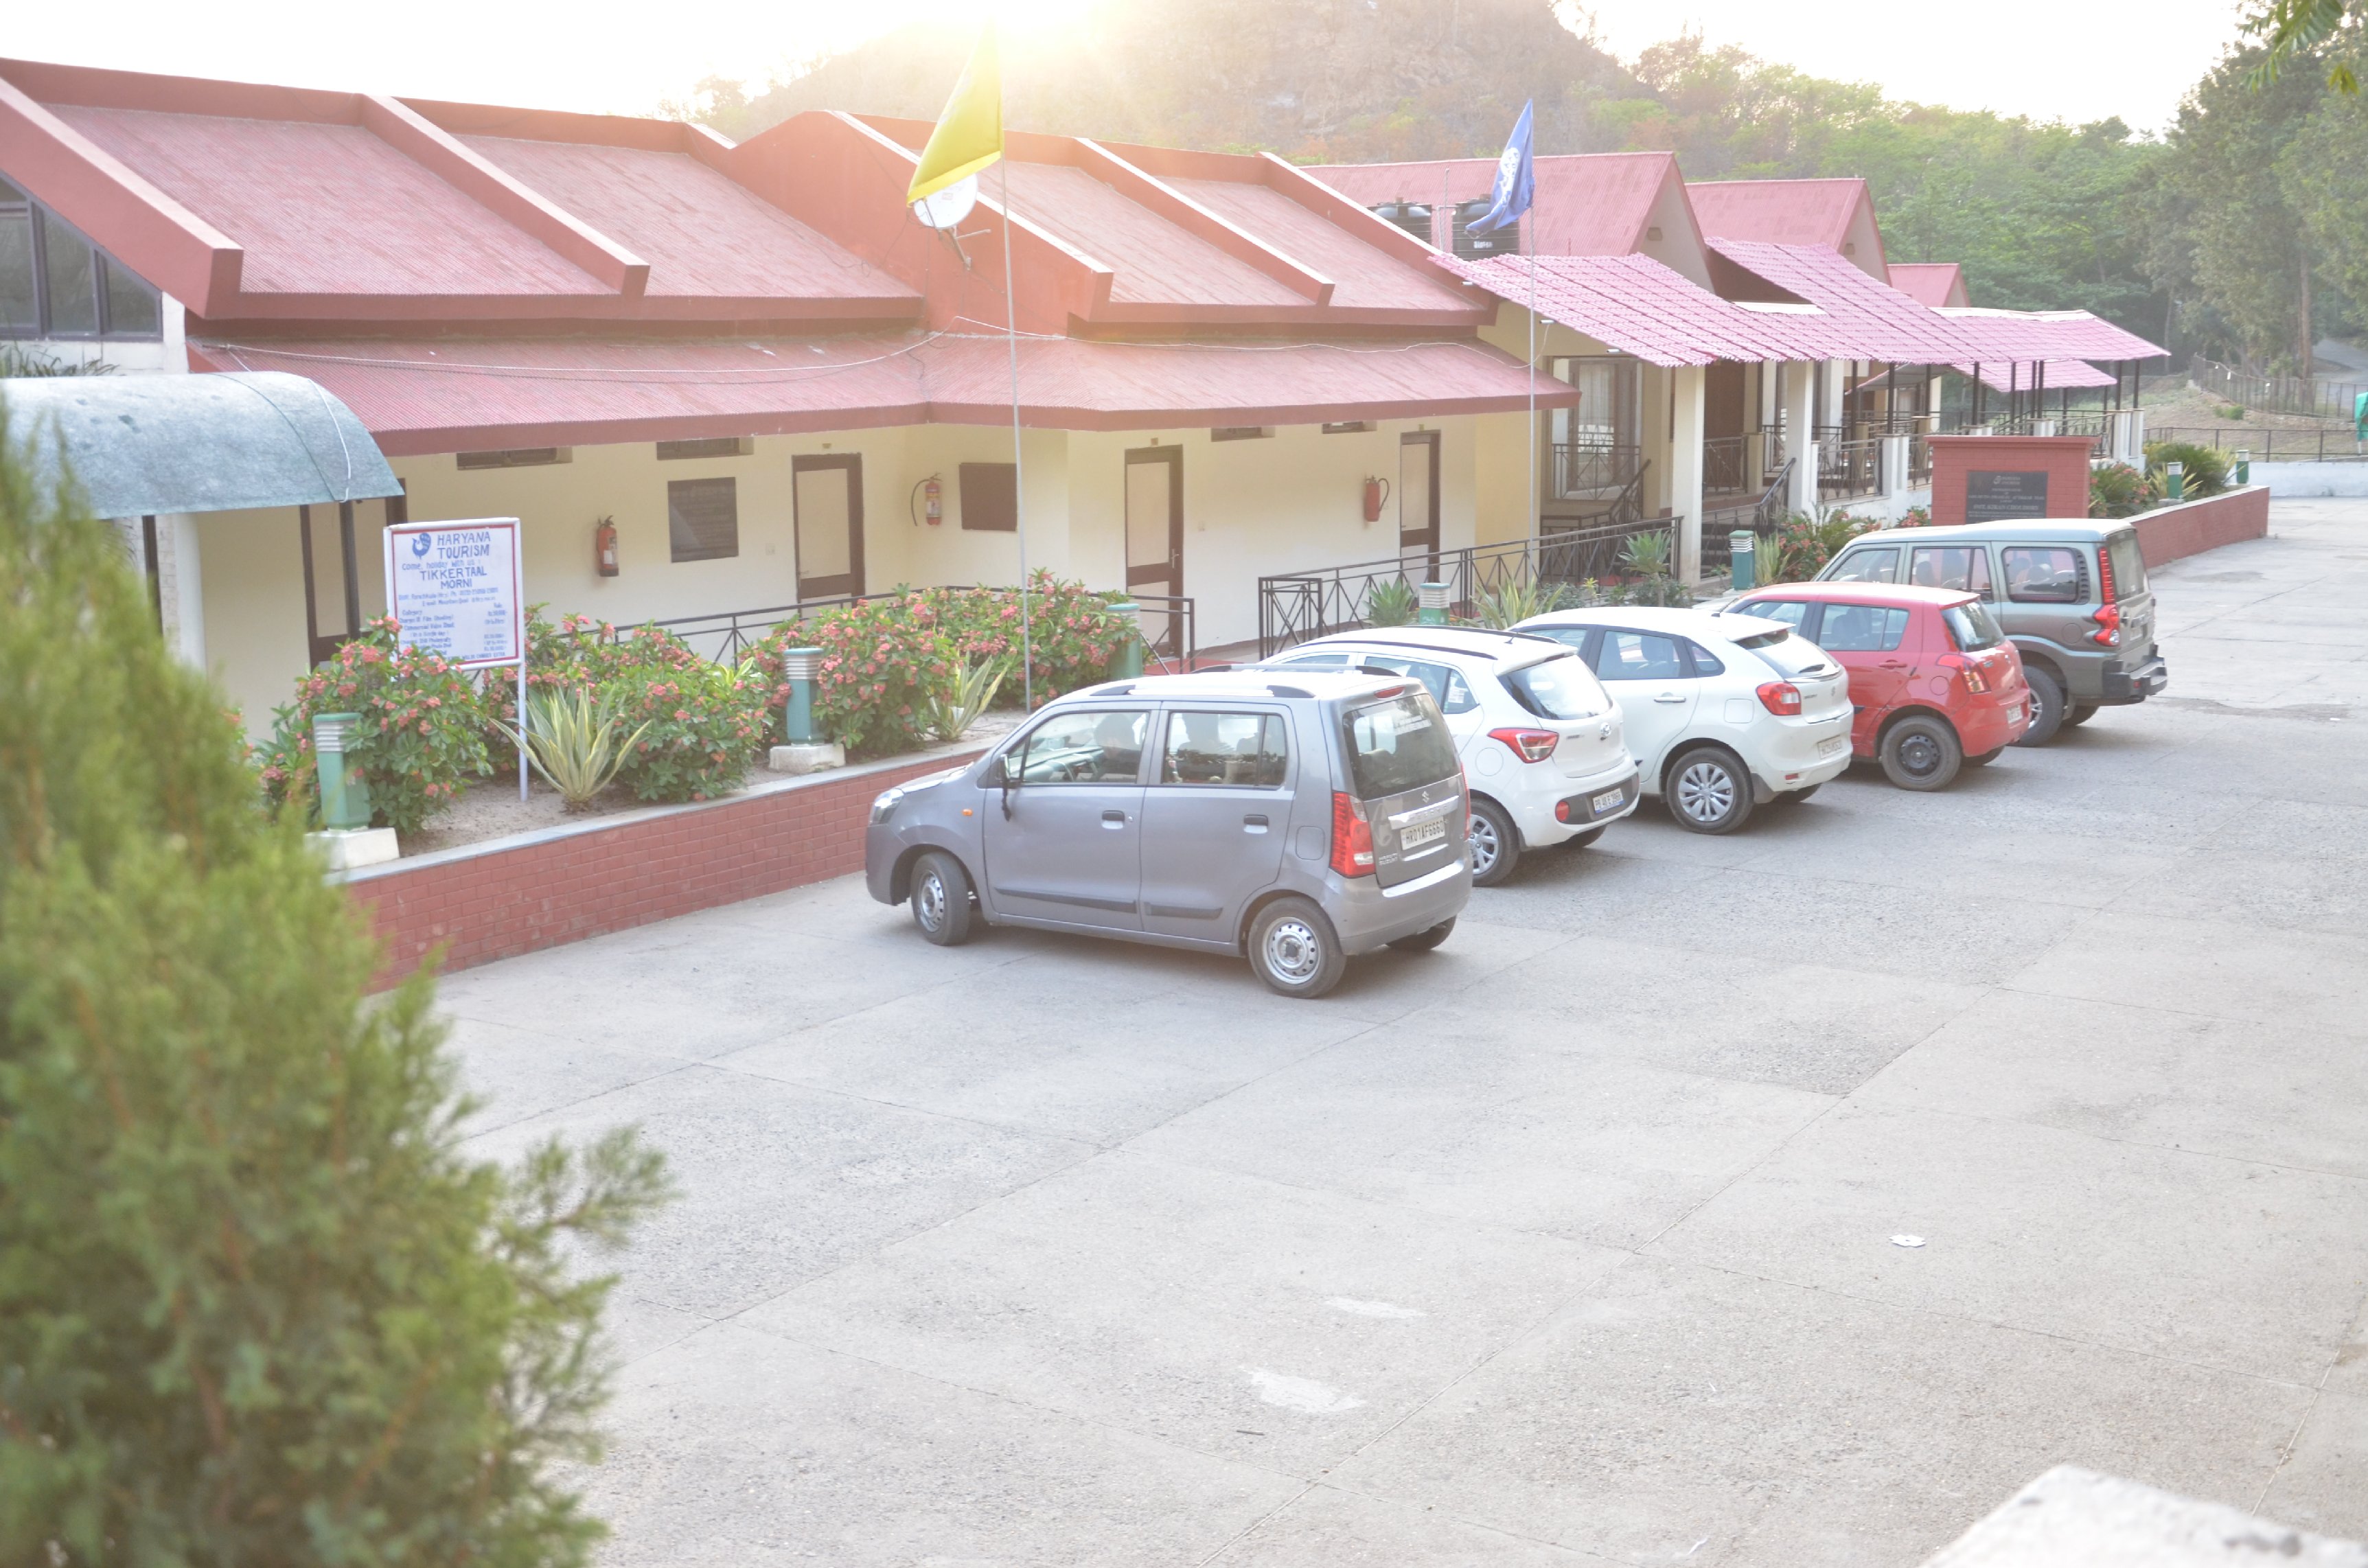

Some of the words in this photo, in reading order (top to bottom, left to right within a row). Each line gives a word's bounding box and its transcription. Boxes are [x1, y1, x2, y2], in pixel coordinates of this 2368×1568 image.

[437, 531, 491, 546] HARYANA
[437, 544, 490, 560] TOURISM
[441, 579, 472, 589] MORNI
